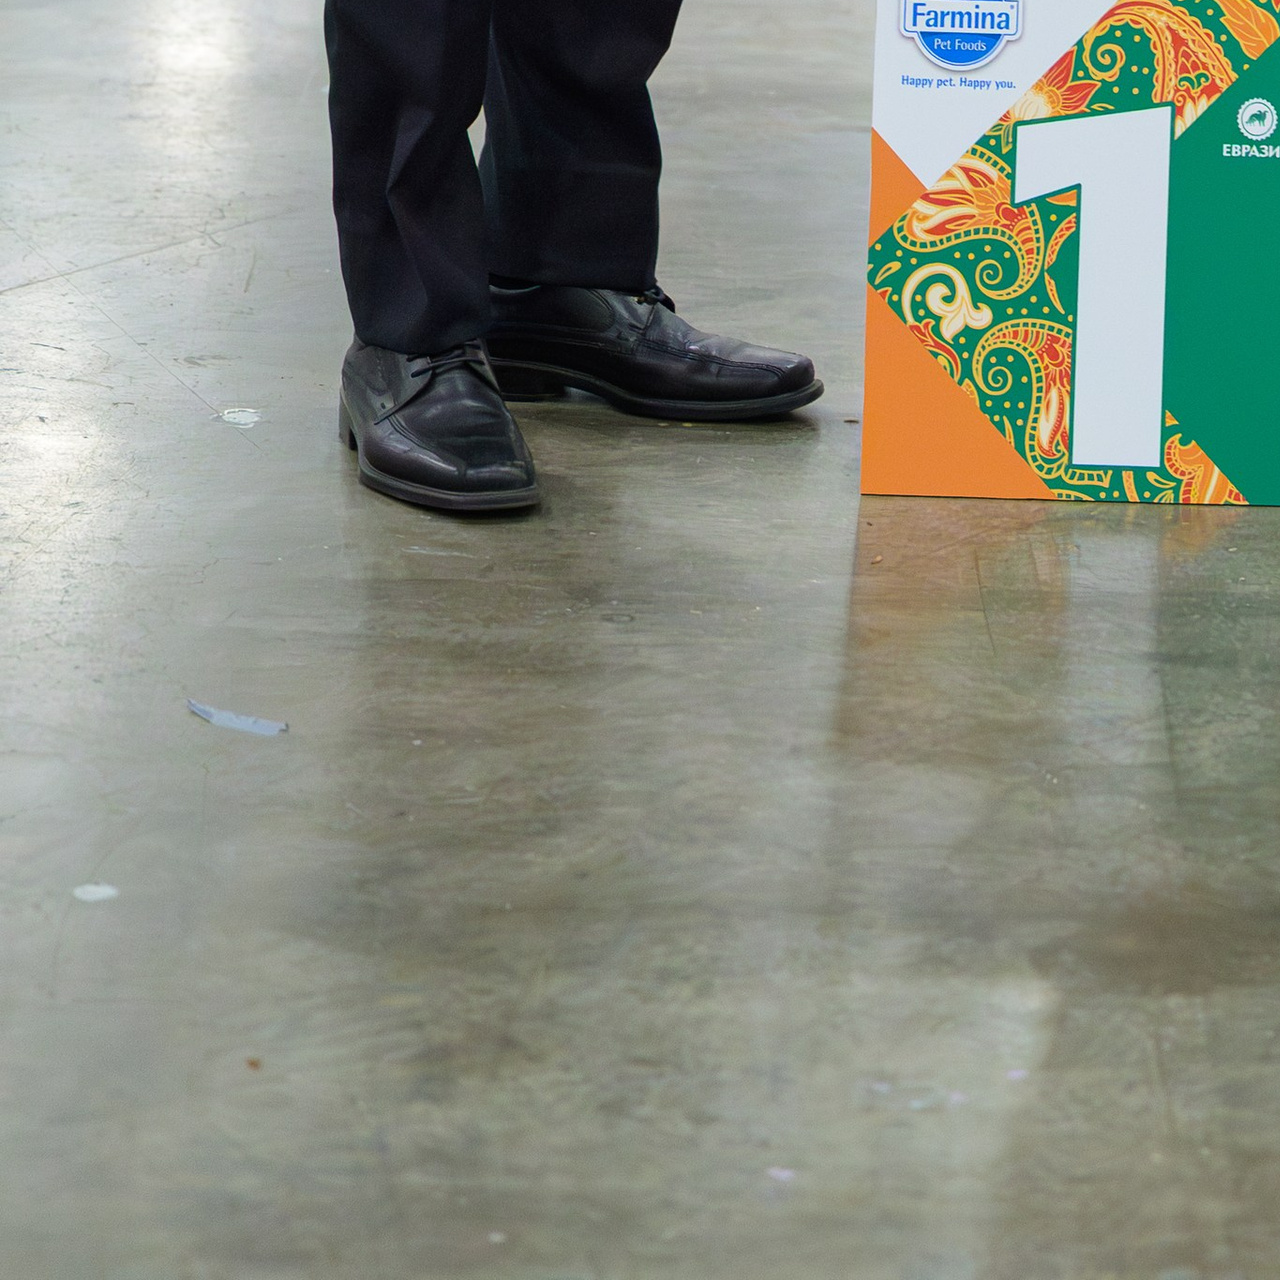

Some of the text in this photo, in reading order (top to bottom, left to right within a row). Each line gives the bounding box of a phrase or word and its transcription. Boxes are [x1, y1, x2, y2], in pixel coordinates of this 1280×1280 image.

[912, 2, 1010, 30] Farmina
[934, 38, 987, 52] Pet Foods
[901, 75, 1017, 90] Happy pet. Happy you.
[1014, 106, 1172, 467] 1
